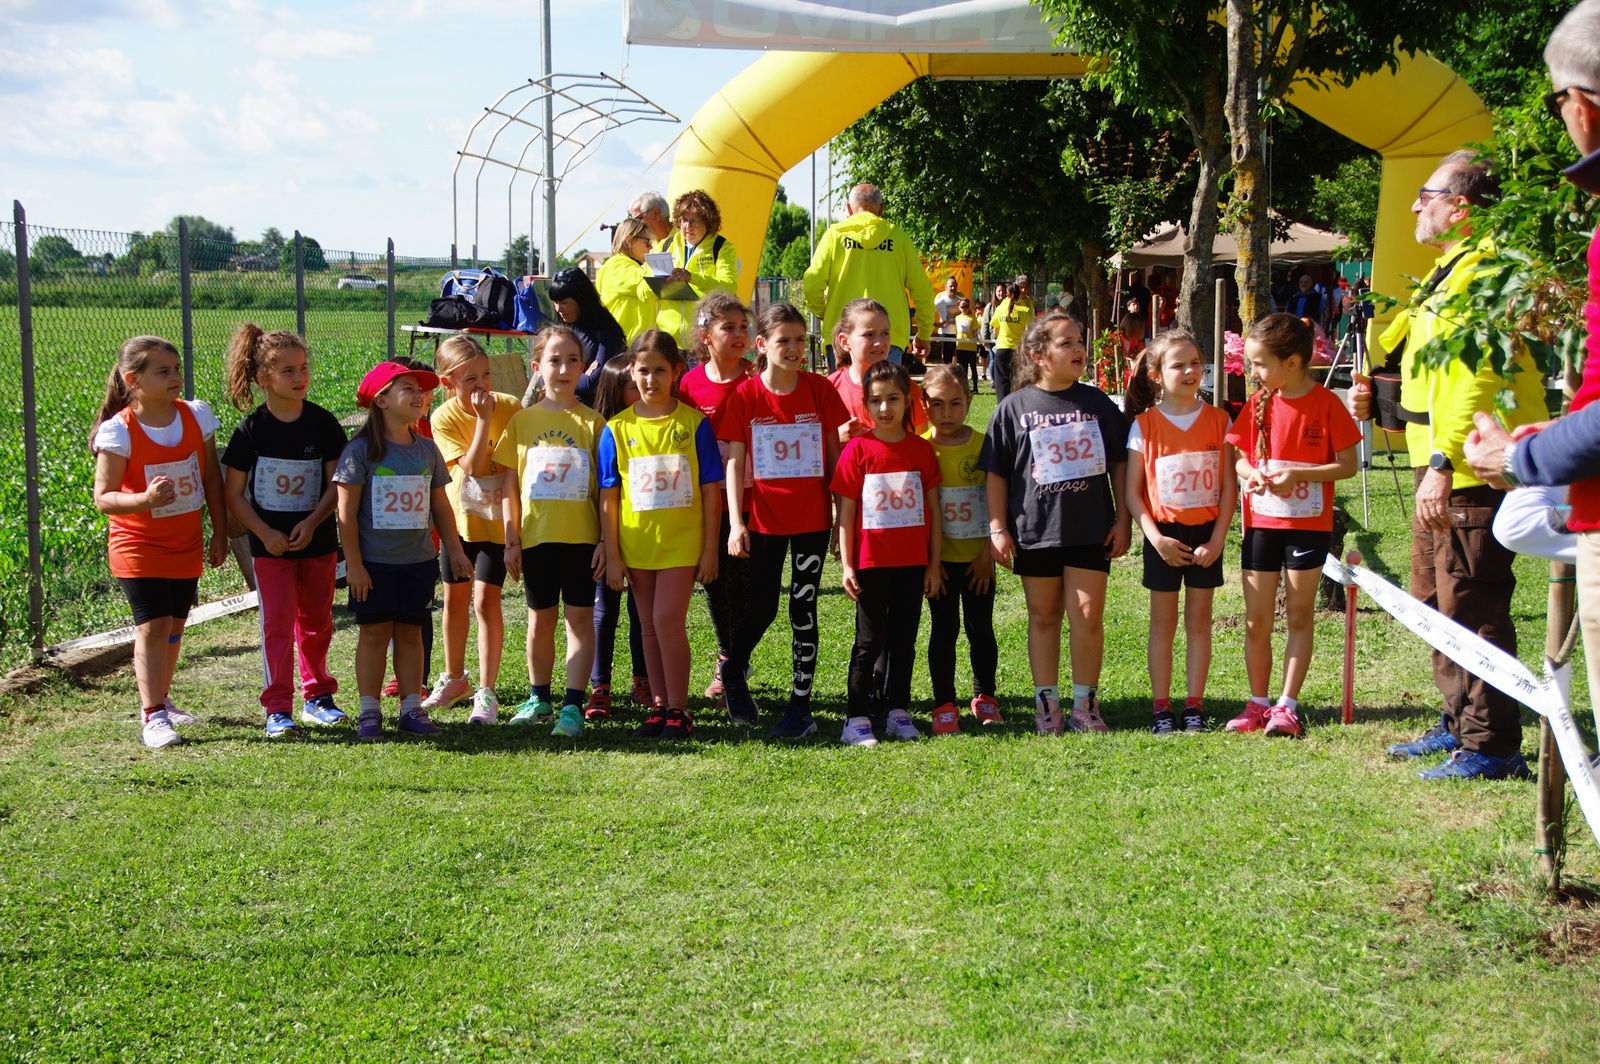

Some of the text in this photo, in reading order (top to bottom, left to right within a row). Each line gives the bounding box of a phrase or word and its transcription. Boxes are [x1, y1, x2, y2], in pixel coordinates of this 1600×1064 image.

[844, 237, 893, 251] GICE
[1020, 410, 1097, 427] Cherries
[773, 440, 801, 461] 91
[1047, 437, 1094, 464] 352
[542, 463, 571, 483] 57
[641, 471, 681, 493] 257
[1172, 469, 1212, 493] 270
[275, 475, 306, 495] 92
[384, 491, 424, 513] 292
[480, 488, 503, 507] 58
[875, 489, 916, 511] 263
[943, 502, 972, 522] 55
